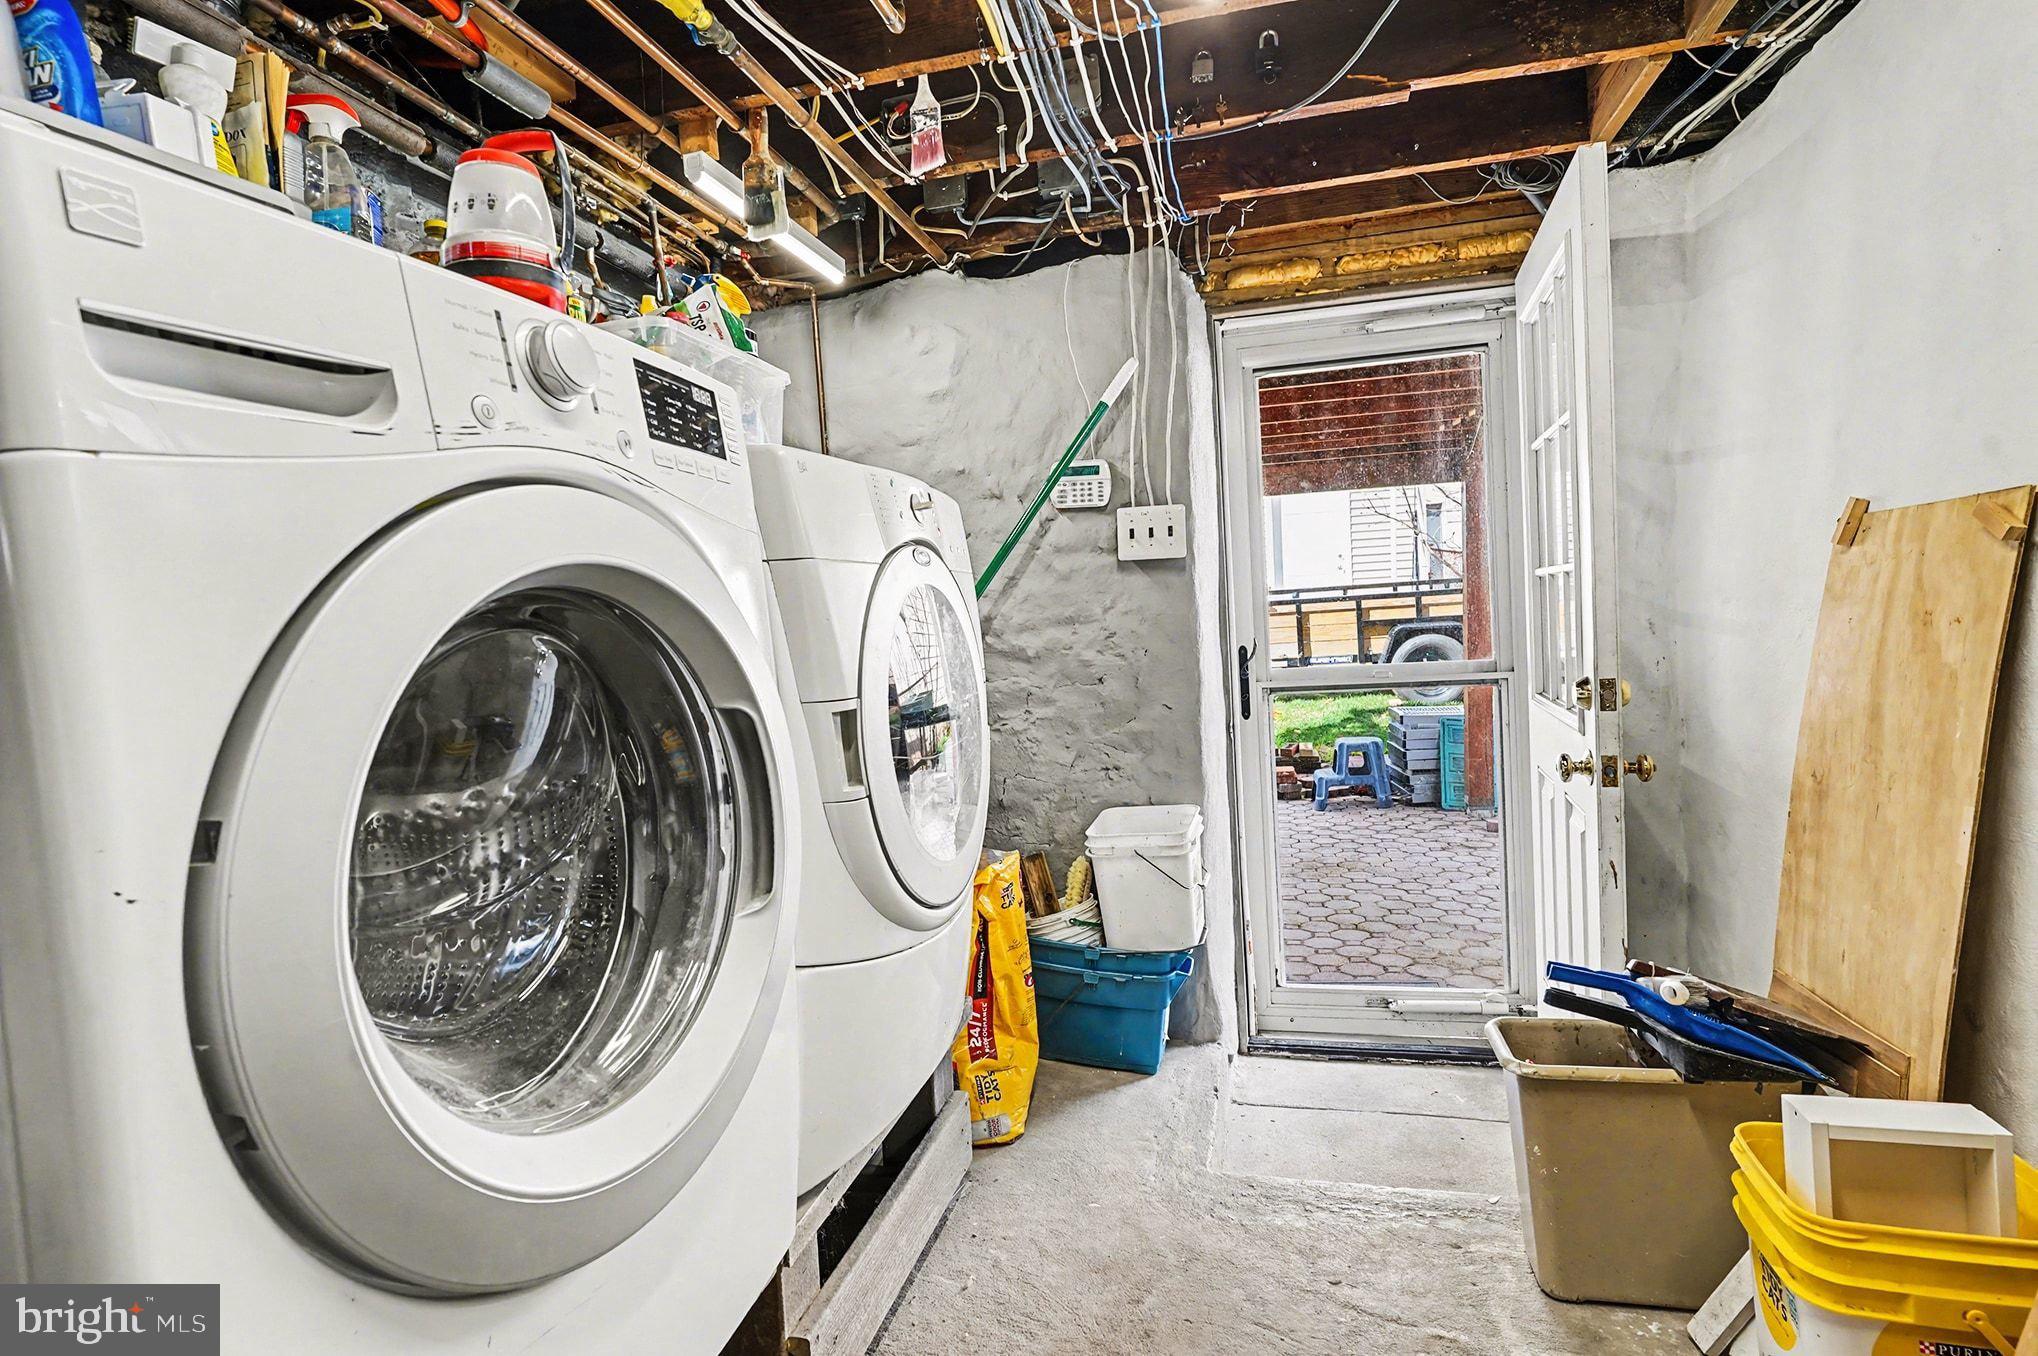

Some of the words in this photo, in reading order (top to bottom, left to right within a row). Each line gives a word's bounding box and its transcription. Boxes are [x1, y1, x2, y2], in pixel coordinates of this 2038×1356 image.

[690, 313, 707, 331] TSP
[980, 1074, 994, 1104] TIDY
[986, 1070, 1002, 1101] CATS
[1762, 1274, 1788, 1322] CATS
